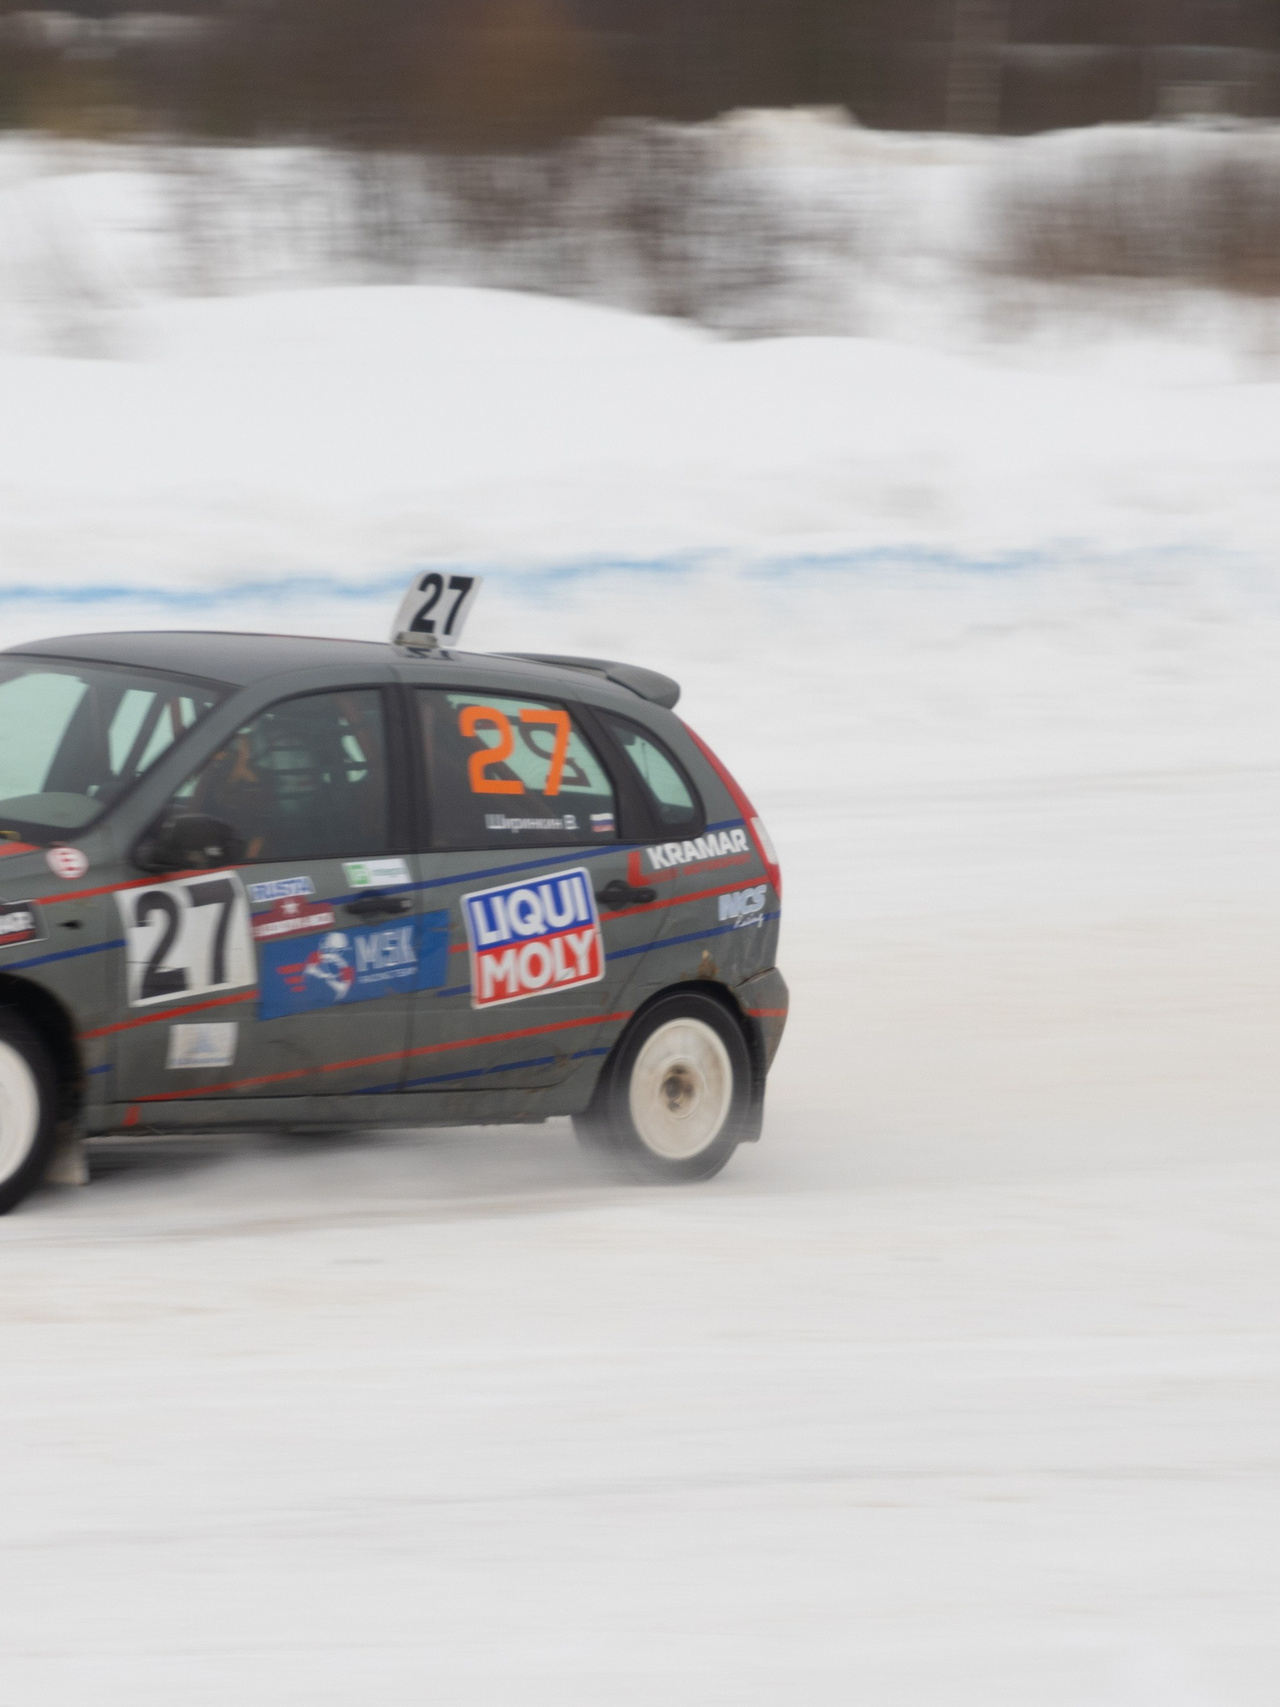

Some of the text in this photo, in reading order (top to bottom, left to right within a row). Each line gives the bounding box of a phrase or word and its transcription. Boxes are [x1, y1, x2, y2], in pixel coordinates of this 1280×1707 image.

[408, 573, 474, 635] 27
[459, 706, 571, 796] 27
[645, 828, 750, 870] KRAMAR
[134, 877, 237, 999] 27
[470, 876, 590, 947] LIQUI
[478, 929, 596, 999] MOLY
